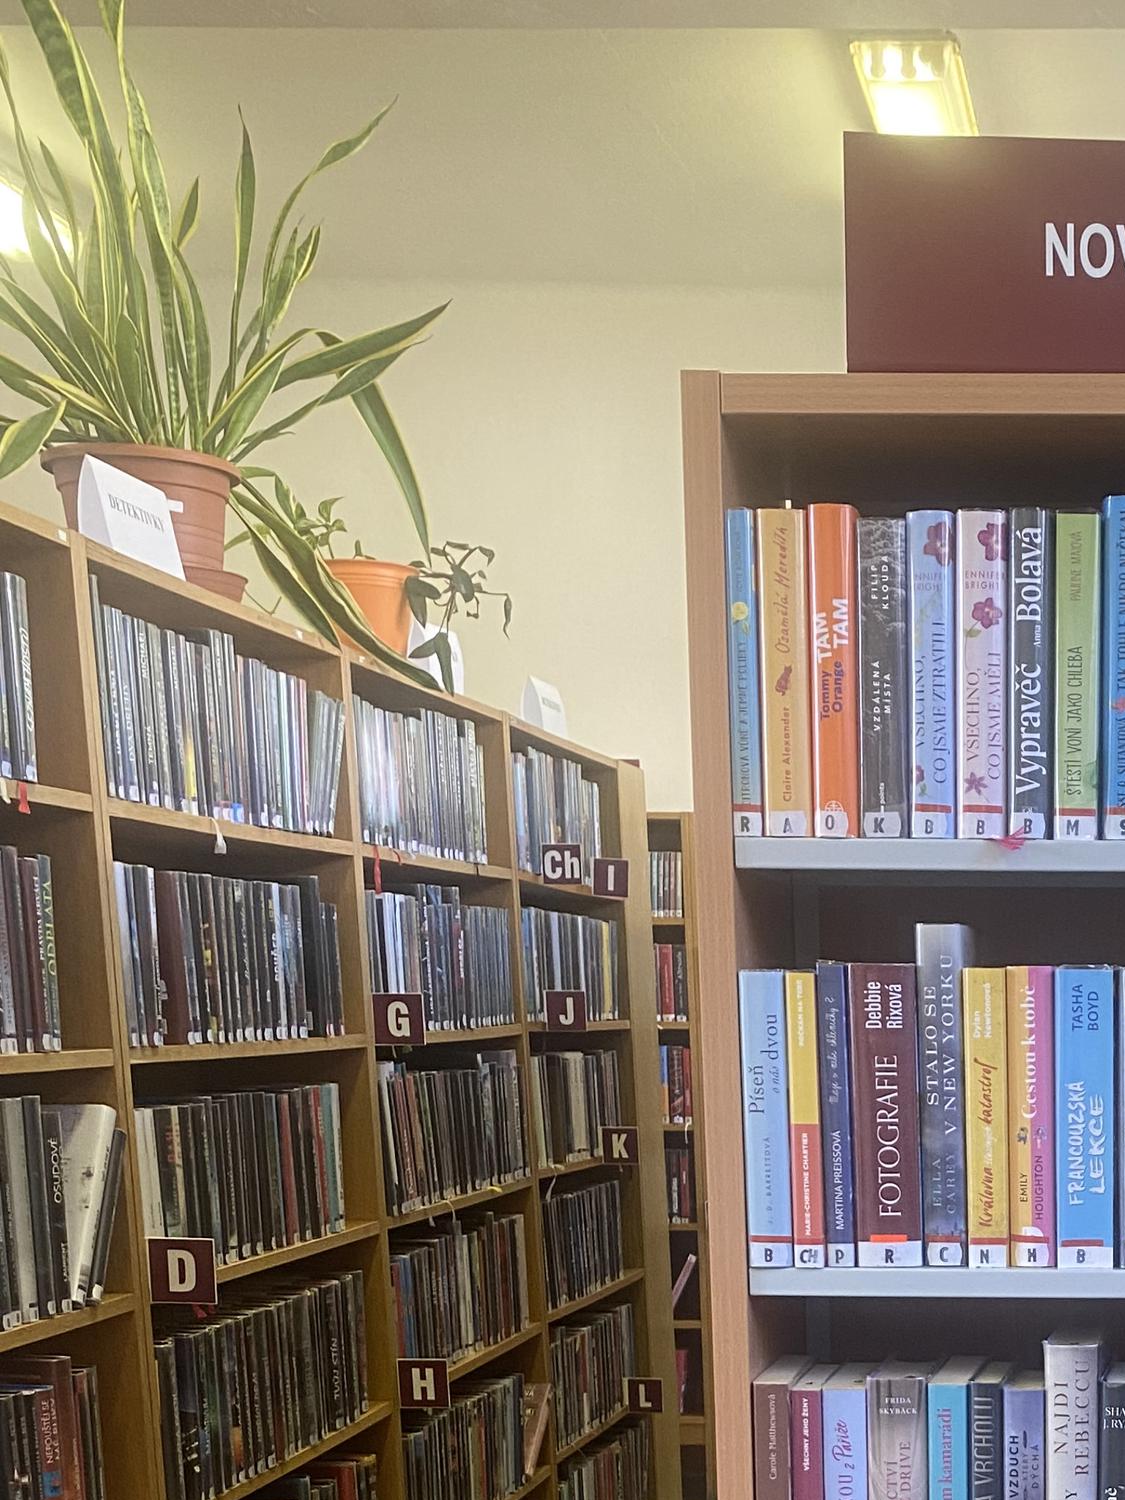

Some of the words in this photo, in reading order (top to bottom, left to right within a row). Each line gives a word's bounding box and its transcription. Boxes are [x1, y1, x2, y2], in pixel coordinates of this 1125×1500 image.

[108, 494, 165, 532] DETEKTIVKY
[881, 555, 889, 609] KLOUDA
[1016, 527, 1042, 621] Bolavá
[814, 612, 832, 663] TAM
[832, 598, 849, 649] TAM
[1033, 625, 1041, 647] Anna
[831, 661, 844, 712] Orange
[1067, 646, 1082, 687] CHLEBA
[820, 671, 833, 720] Tommy
[870, 660, 881, 731] VZDÁLENÁ
[882, 673, 891, 714] MÍSTA
[1067, 693, 1082, 722] JAKO
[1015, 663, 1047, 794] Vypravěč
[1066, 727, 1082, 752] VONÍ
[1066, 760, 1082, 795] ŠTĚSTÍ
[544, 850, 580, 880] Ch
[607, 864, 615, 891] I
[387, 1000, 411, 1038] G
[558, 996, 574, 1026] J
[865, 982, 882, 1029] Debbie
[885, 984, 904, 1029] Rixová
[924, 986, 936, 1017] SE
[941, 954, 954, 1042] YORKU
[1071, 985, 1083, 1031] TASHA
[1088, 991, 1099, 1031] BOYD
[925, 1025, 939, 1105] STALO
[944, 1053, 956, 1112] NEW
[611, 1133, 630, 1158] K
[875, 1055, 901, 1217] FOTOGRAFIE
[945, 1122, 957, 1135] V
[48, 1137, 62, 1203] OSUDOVÉ
[830, 1130, 843, 1183] PREISSOVÁ
[833, 1185, 844, 1229] MARTINA
[167, 1249, 196, 1293] D
[412, 1368, 435, 1400] H
[639, 1383, 652, 1408] L
[1054, 1380, 1069, 1454] NAJDI
[1075, 1360, 1090, 1475] REBECCU
[974, 1397, 993, 1484] VRCHOLU
